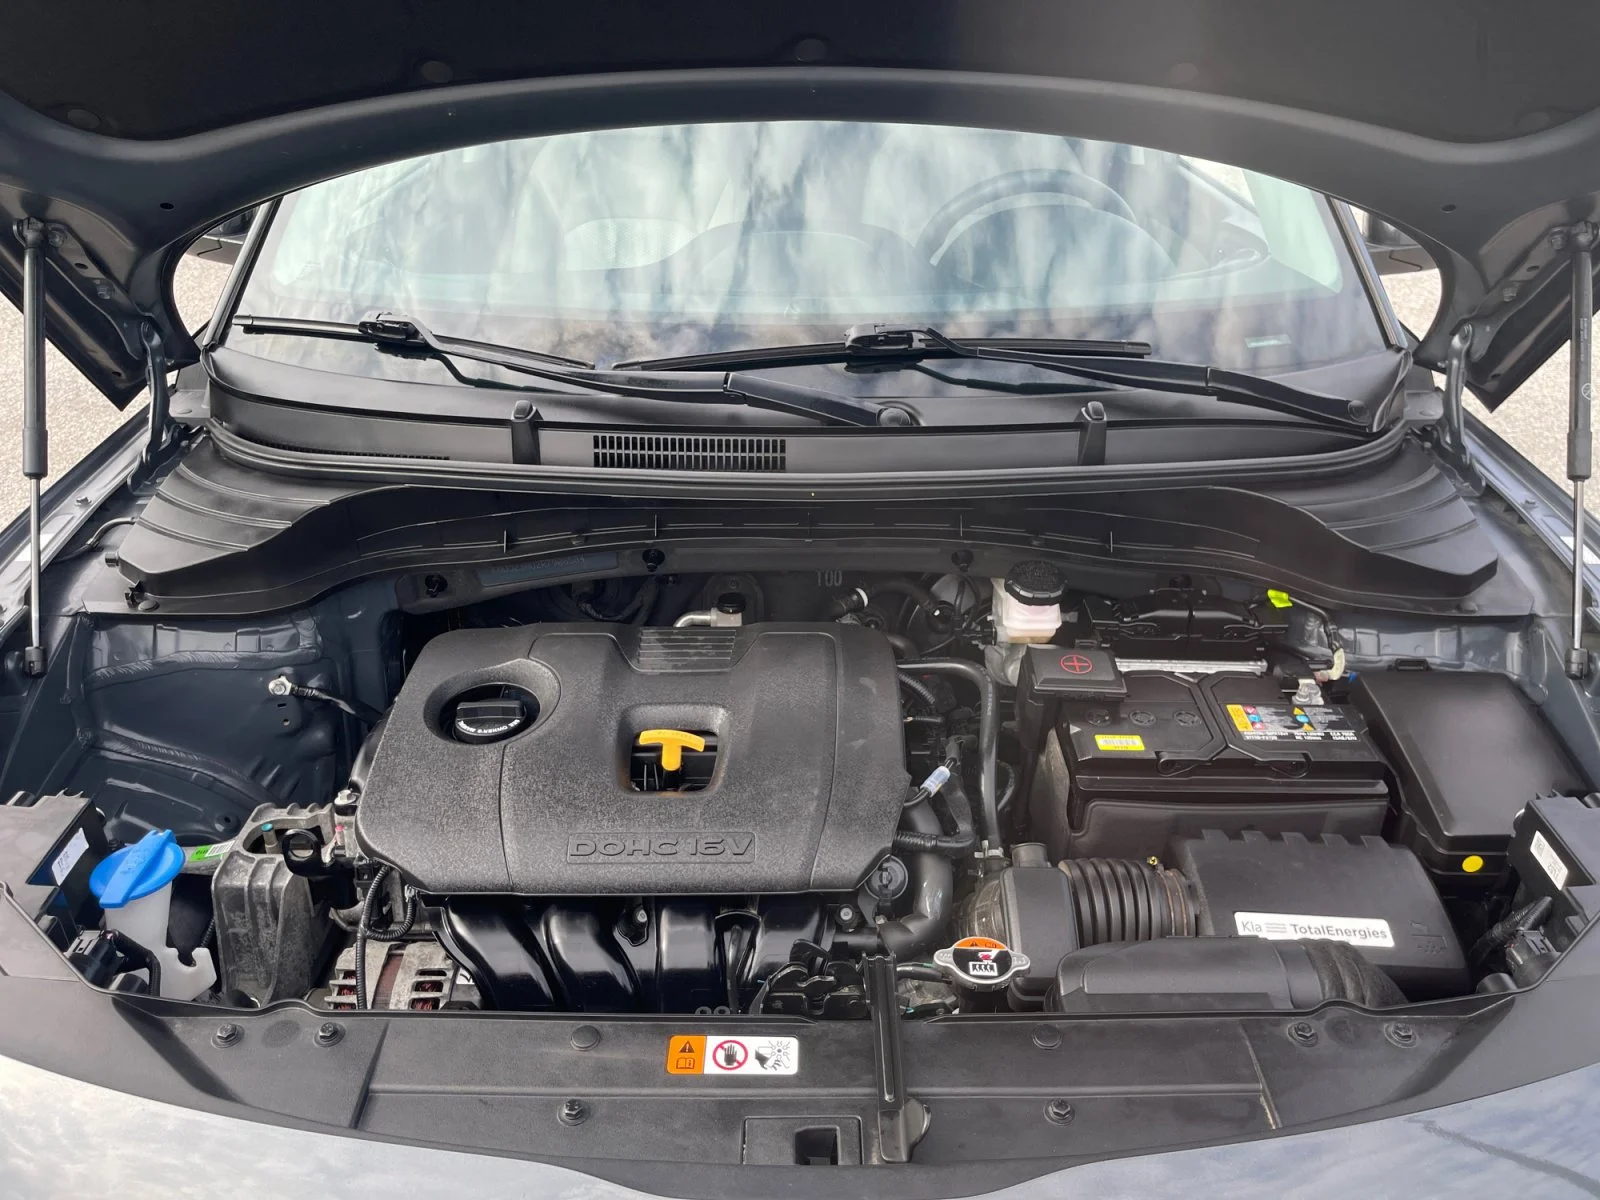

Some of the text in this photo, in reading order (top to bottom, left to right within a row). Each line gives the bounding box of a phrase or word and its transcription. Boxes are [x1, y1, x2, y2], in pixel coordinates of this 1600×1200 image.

[570, 838, 753, 856] DOHC 16V
[1290, 923, 1388, 940] TotalEnergies
